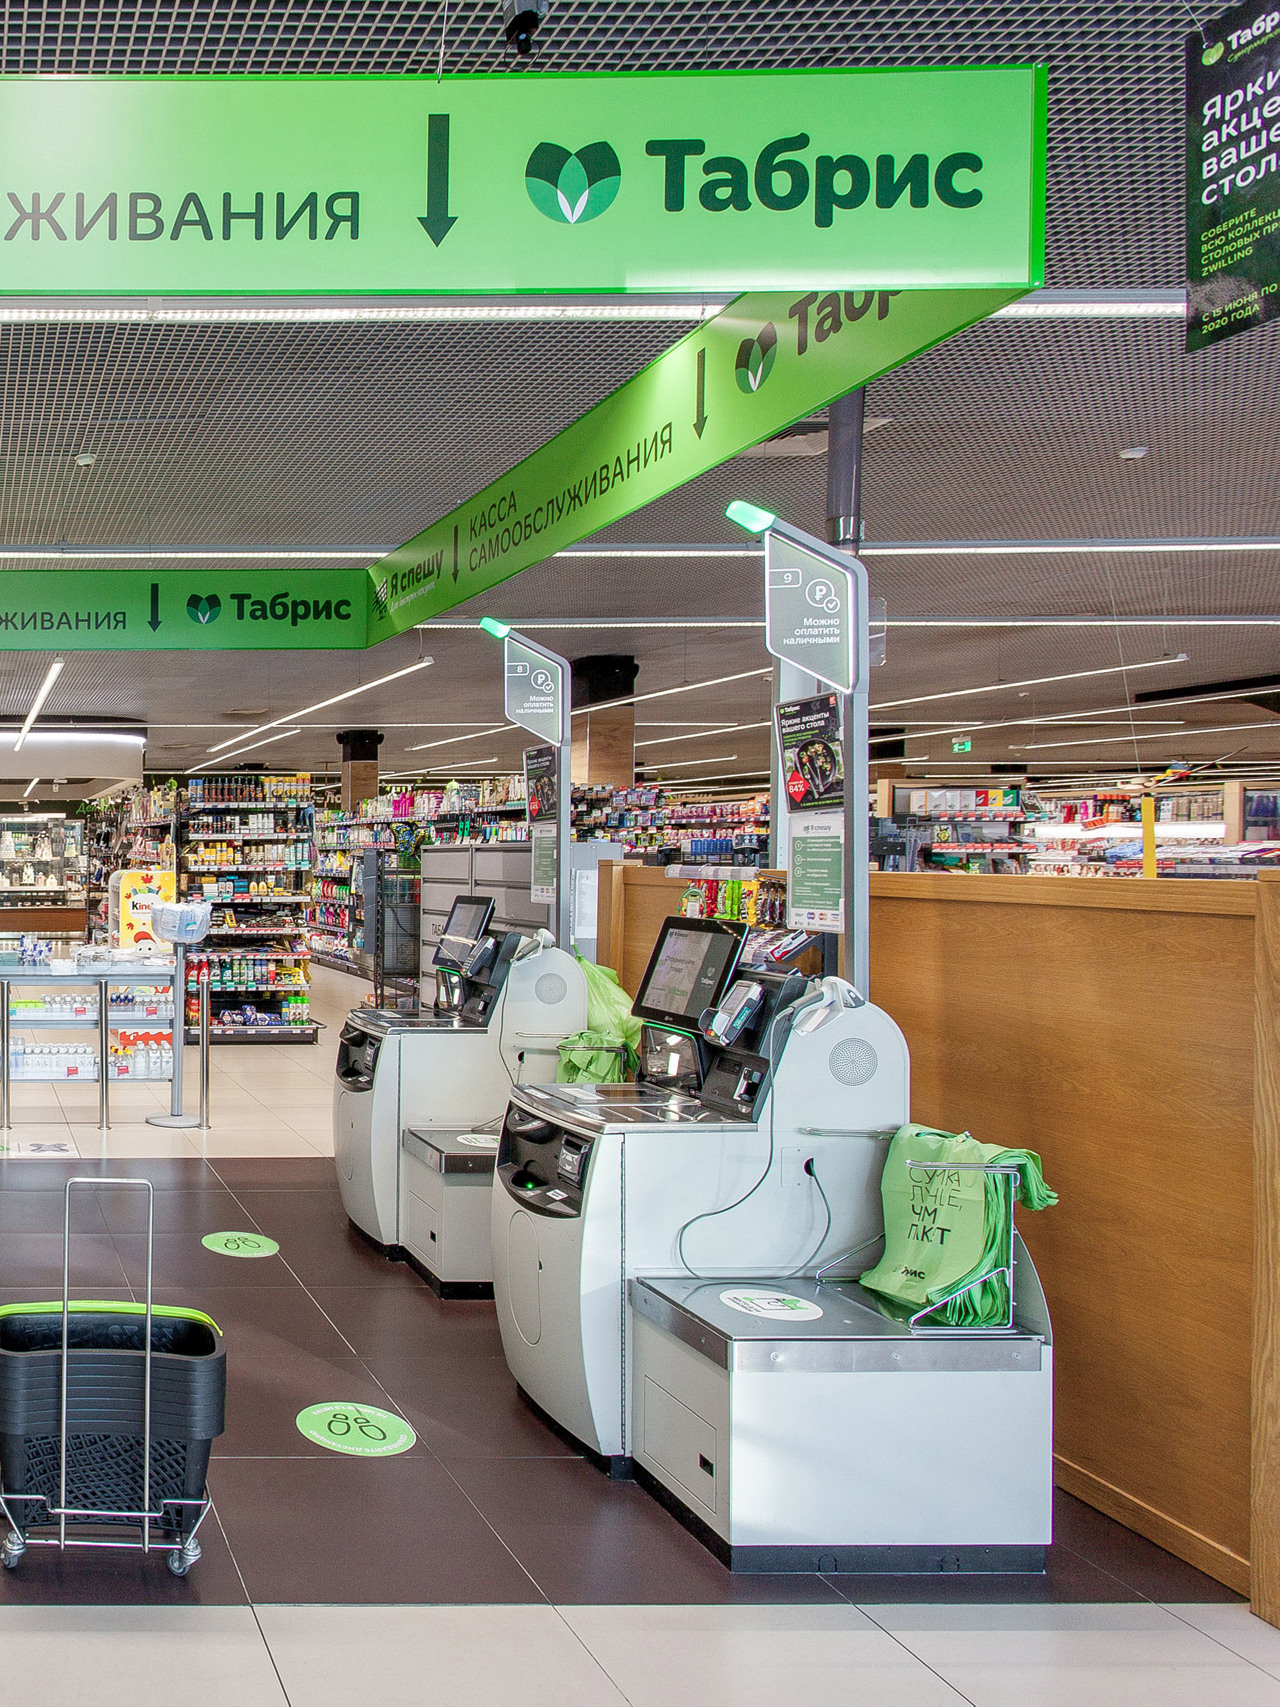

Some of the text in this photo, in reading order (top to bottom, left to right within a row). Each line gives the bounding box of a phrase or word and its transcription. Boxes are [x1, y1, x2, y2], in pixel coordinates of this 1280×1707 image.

[645, 132, 984, 229] Табрис
[1202, 153, 1280, 205] стол
[1201, 207, 1257, 242] СОБЕРИТЕ
[1201, 236, 1226, 254] ВСЮ
[1201, 230, 1260, 265] СТОЛОВЫХ
[1202, 246, 1254, 277] ZWILLING
[1202, 313, 1209, 321] С
[1225, 291, 1258, 314] ИЮНЯ
[1261, 283, 1279, 297] ПО
[1202, 304, 1260, 335] 2020 ГОДА
[468, 421, 673, 573] САМООБСЛУЖИВАНИЯ
[469, 489, 517, 543] КАССА
[391, 549, 444, 600] Я спешу
[783, 573, 792, 584] 9
[230, 593, 352, 628] Табрис
[803, 617, 840, 626] Можно
[783, 636, 840, 645] наличными
[794, 627, 840, 635] оплатить
[516, 665, 523, 673] 8
[788, 784, 805, 793] 84%
